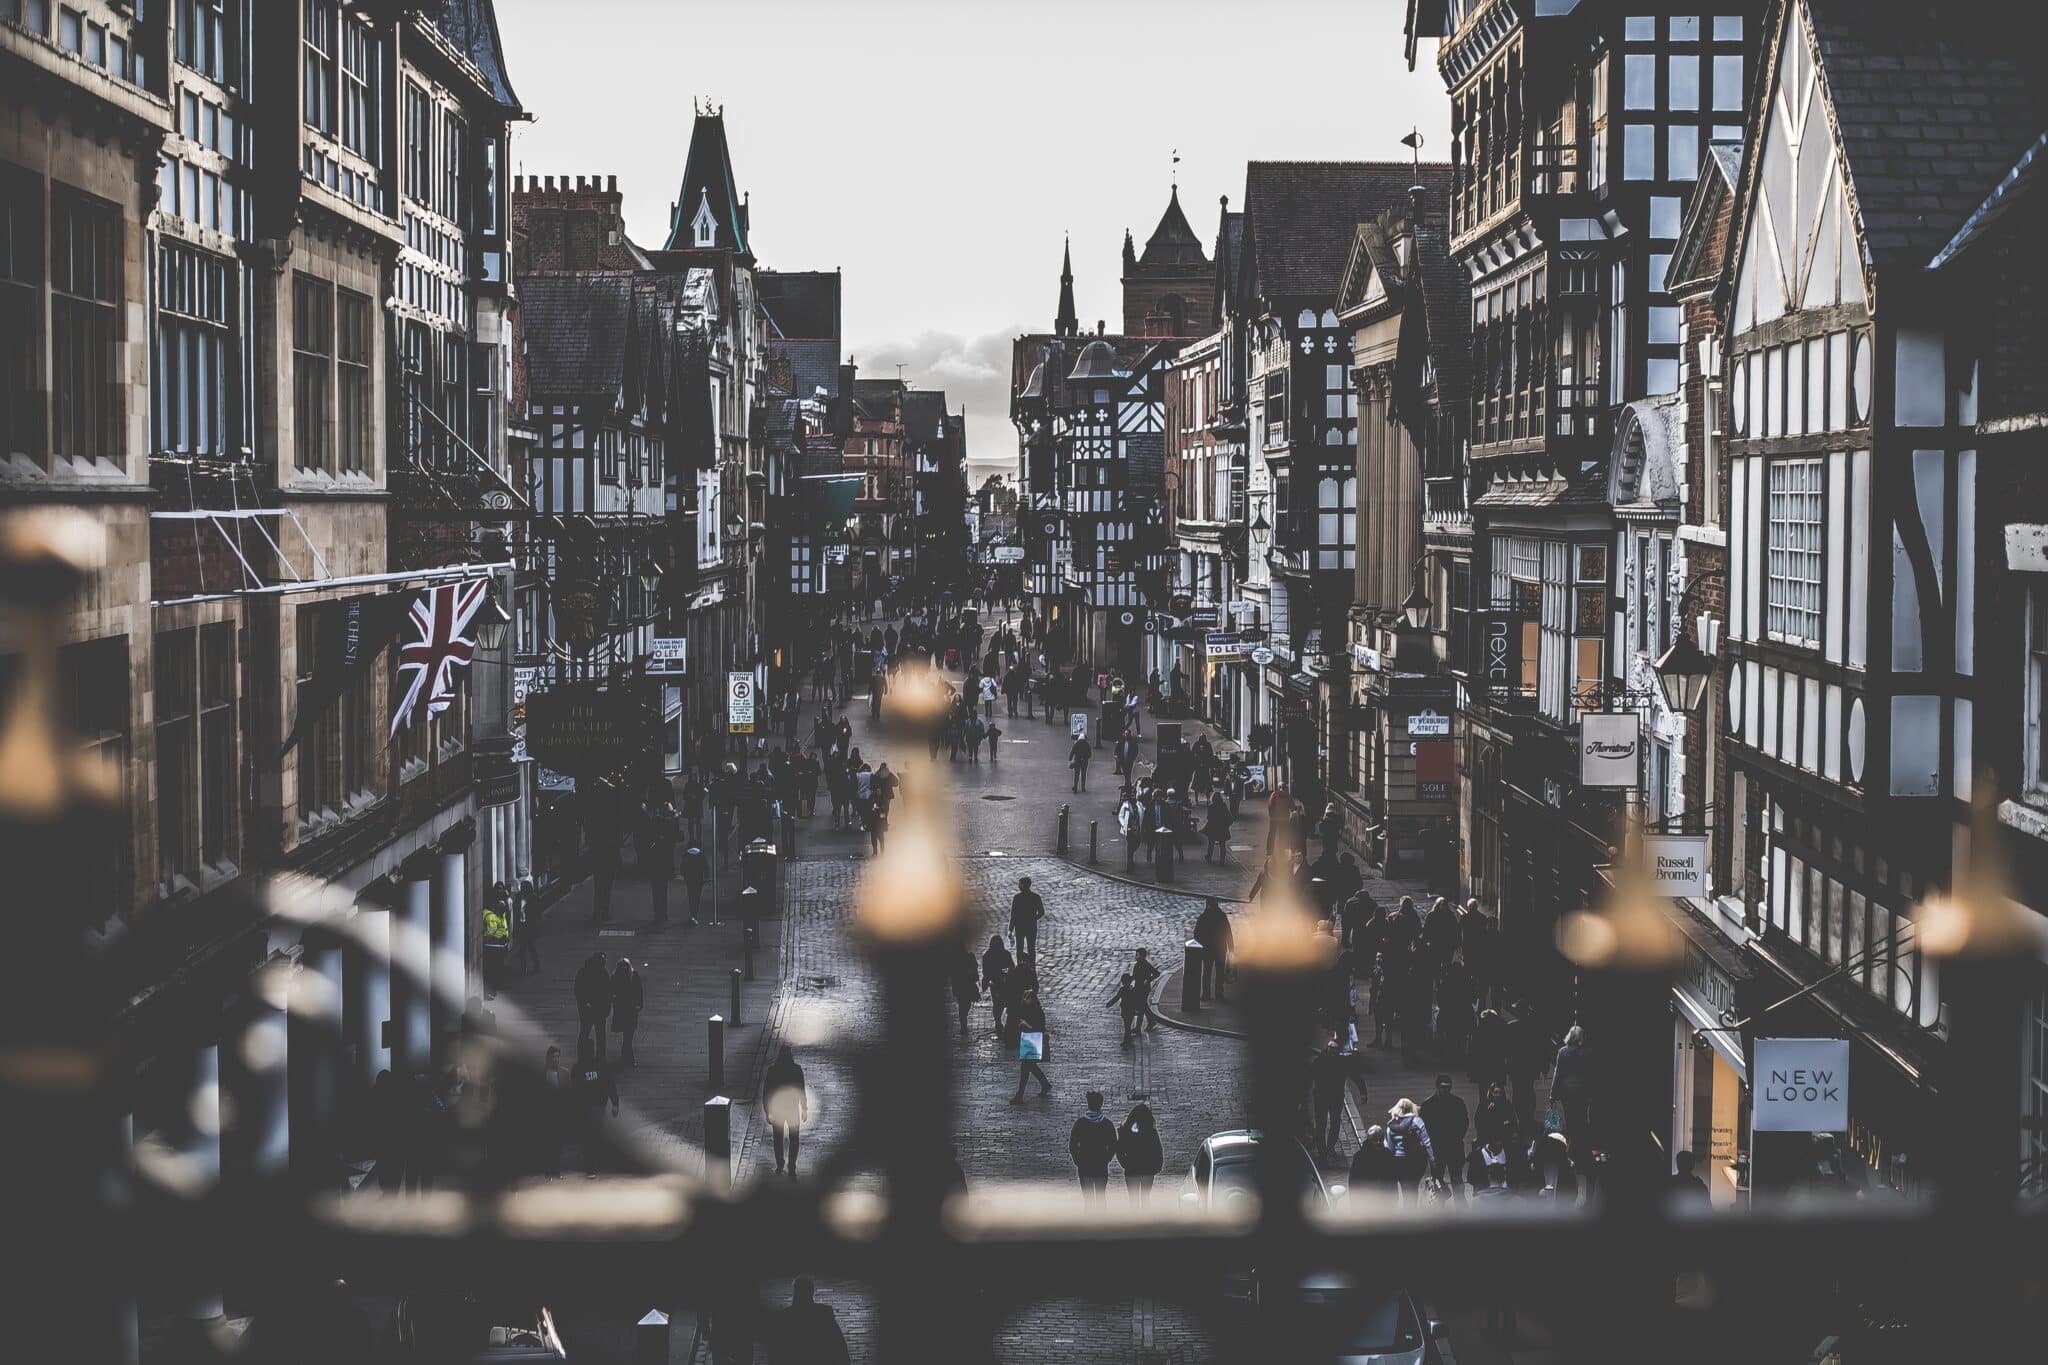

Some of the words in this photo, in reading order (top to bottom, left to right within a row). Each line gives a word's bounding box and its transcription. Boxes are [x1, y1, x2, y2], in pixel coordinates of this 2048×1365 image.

[1208, 646, 1222, 654] TO
[1489, 621, 1507, 679] next
[1585, 740, 1635, 759] Thorntons
[1422, 783, 1448, 792] SOLE
[1656, 856, 1694, 868] Russell
[1655, 868, 1700, 883] Bromley
[1772, 1070, 1833, 1085] NEW
[1766, 1086, 1839, 1102] LOOK
